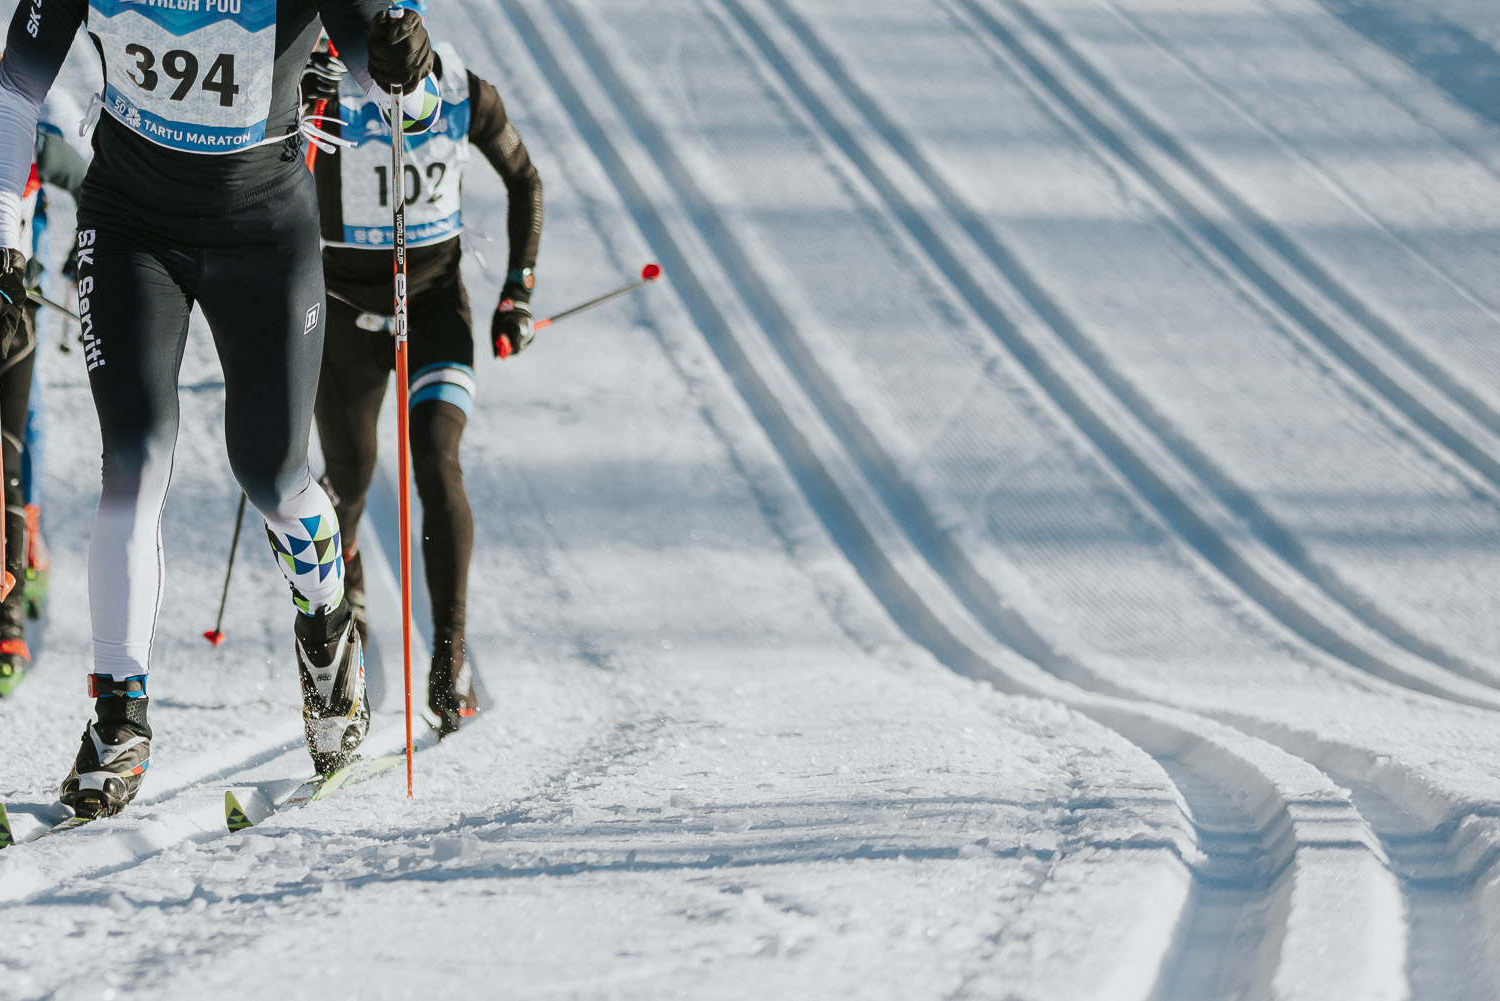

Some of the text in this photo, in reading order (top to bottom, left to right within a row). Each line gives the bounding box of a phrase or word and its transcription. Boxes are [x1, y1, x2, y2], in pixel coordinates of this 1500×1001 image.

[27, 6, 41, 38] SK
[126, 43, 239, 107] 394
[114, 99, 250, 146] 50 TARTU MARATON
[374, 162, 446, 206] 102
[396, 214, 404, 244] WORLD
[396, 245, 404, 265] CUP
[77, 229, 105, 372] SK Serviti
